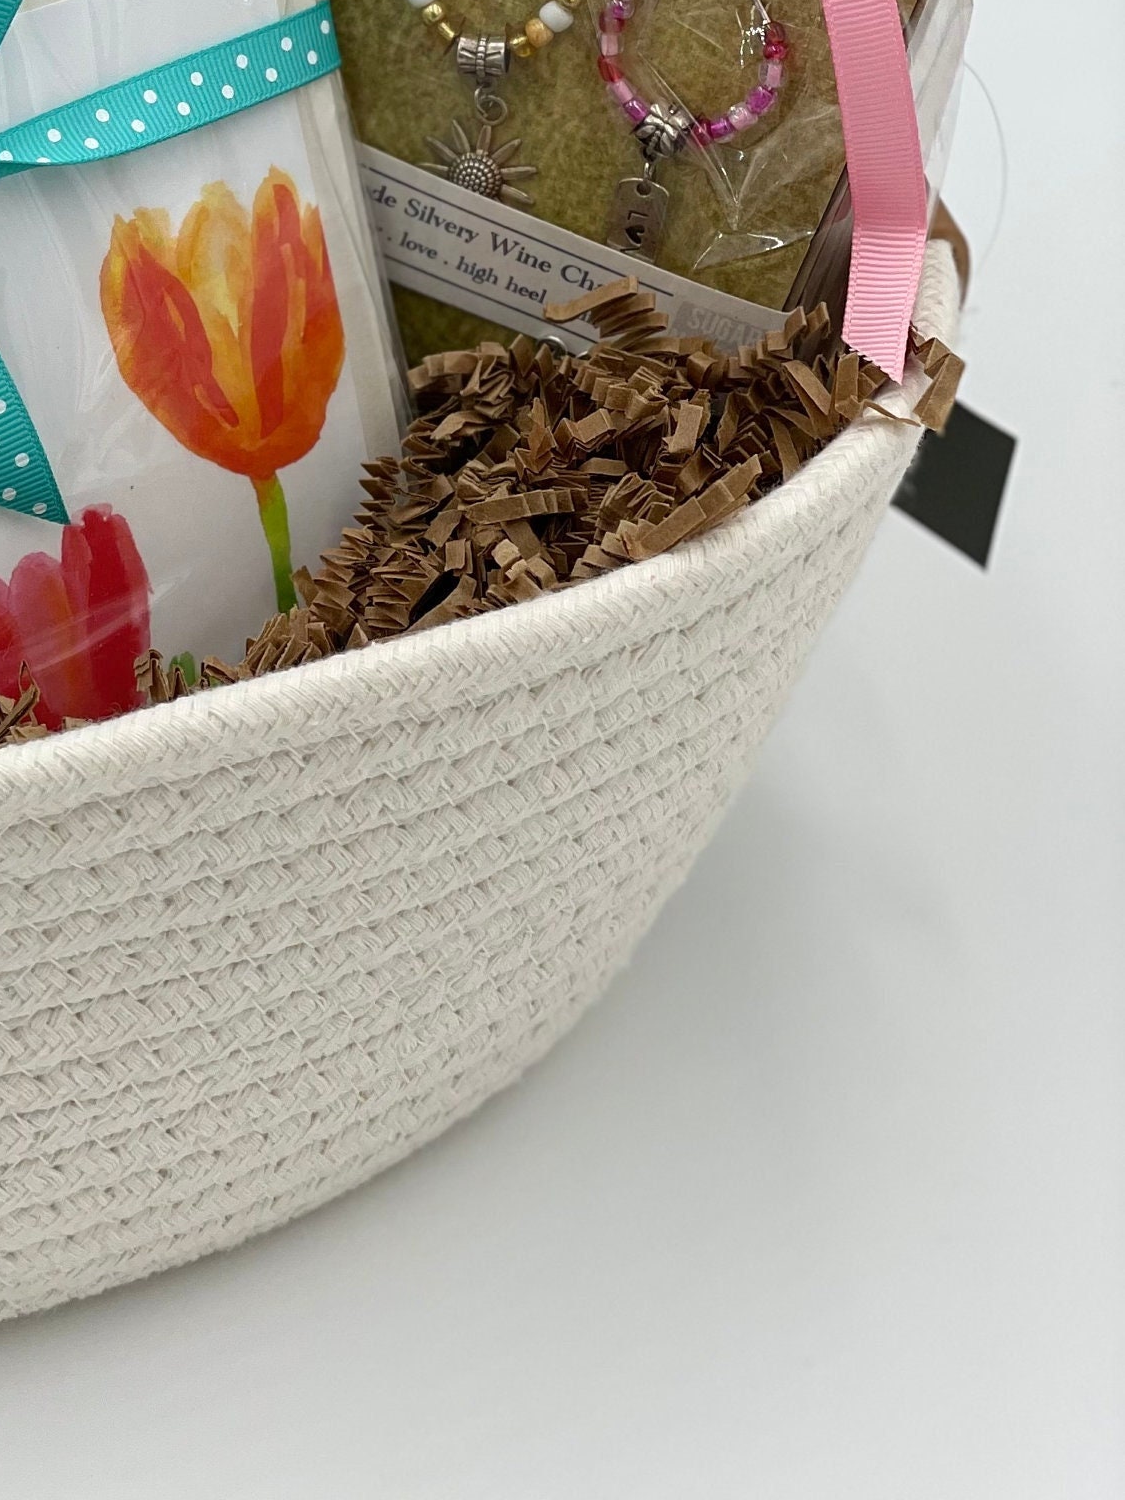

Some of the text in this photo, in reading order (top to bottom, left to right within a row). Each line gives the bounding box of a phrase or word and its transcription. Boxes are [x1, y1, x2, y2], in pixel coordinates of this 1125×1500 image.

[398, 231, 438, 260] love
[455, 255, 499, 285] high
[404, 198, 480, 244] Silvery
[490, 231, 553, 273] Wine
[560, 264, 603, 292] Ch
